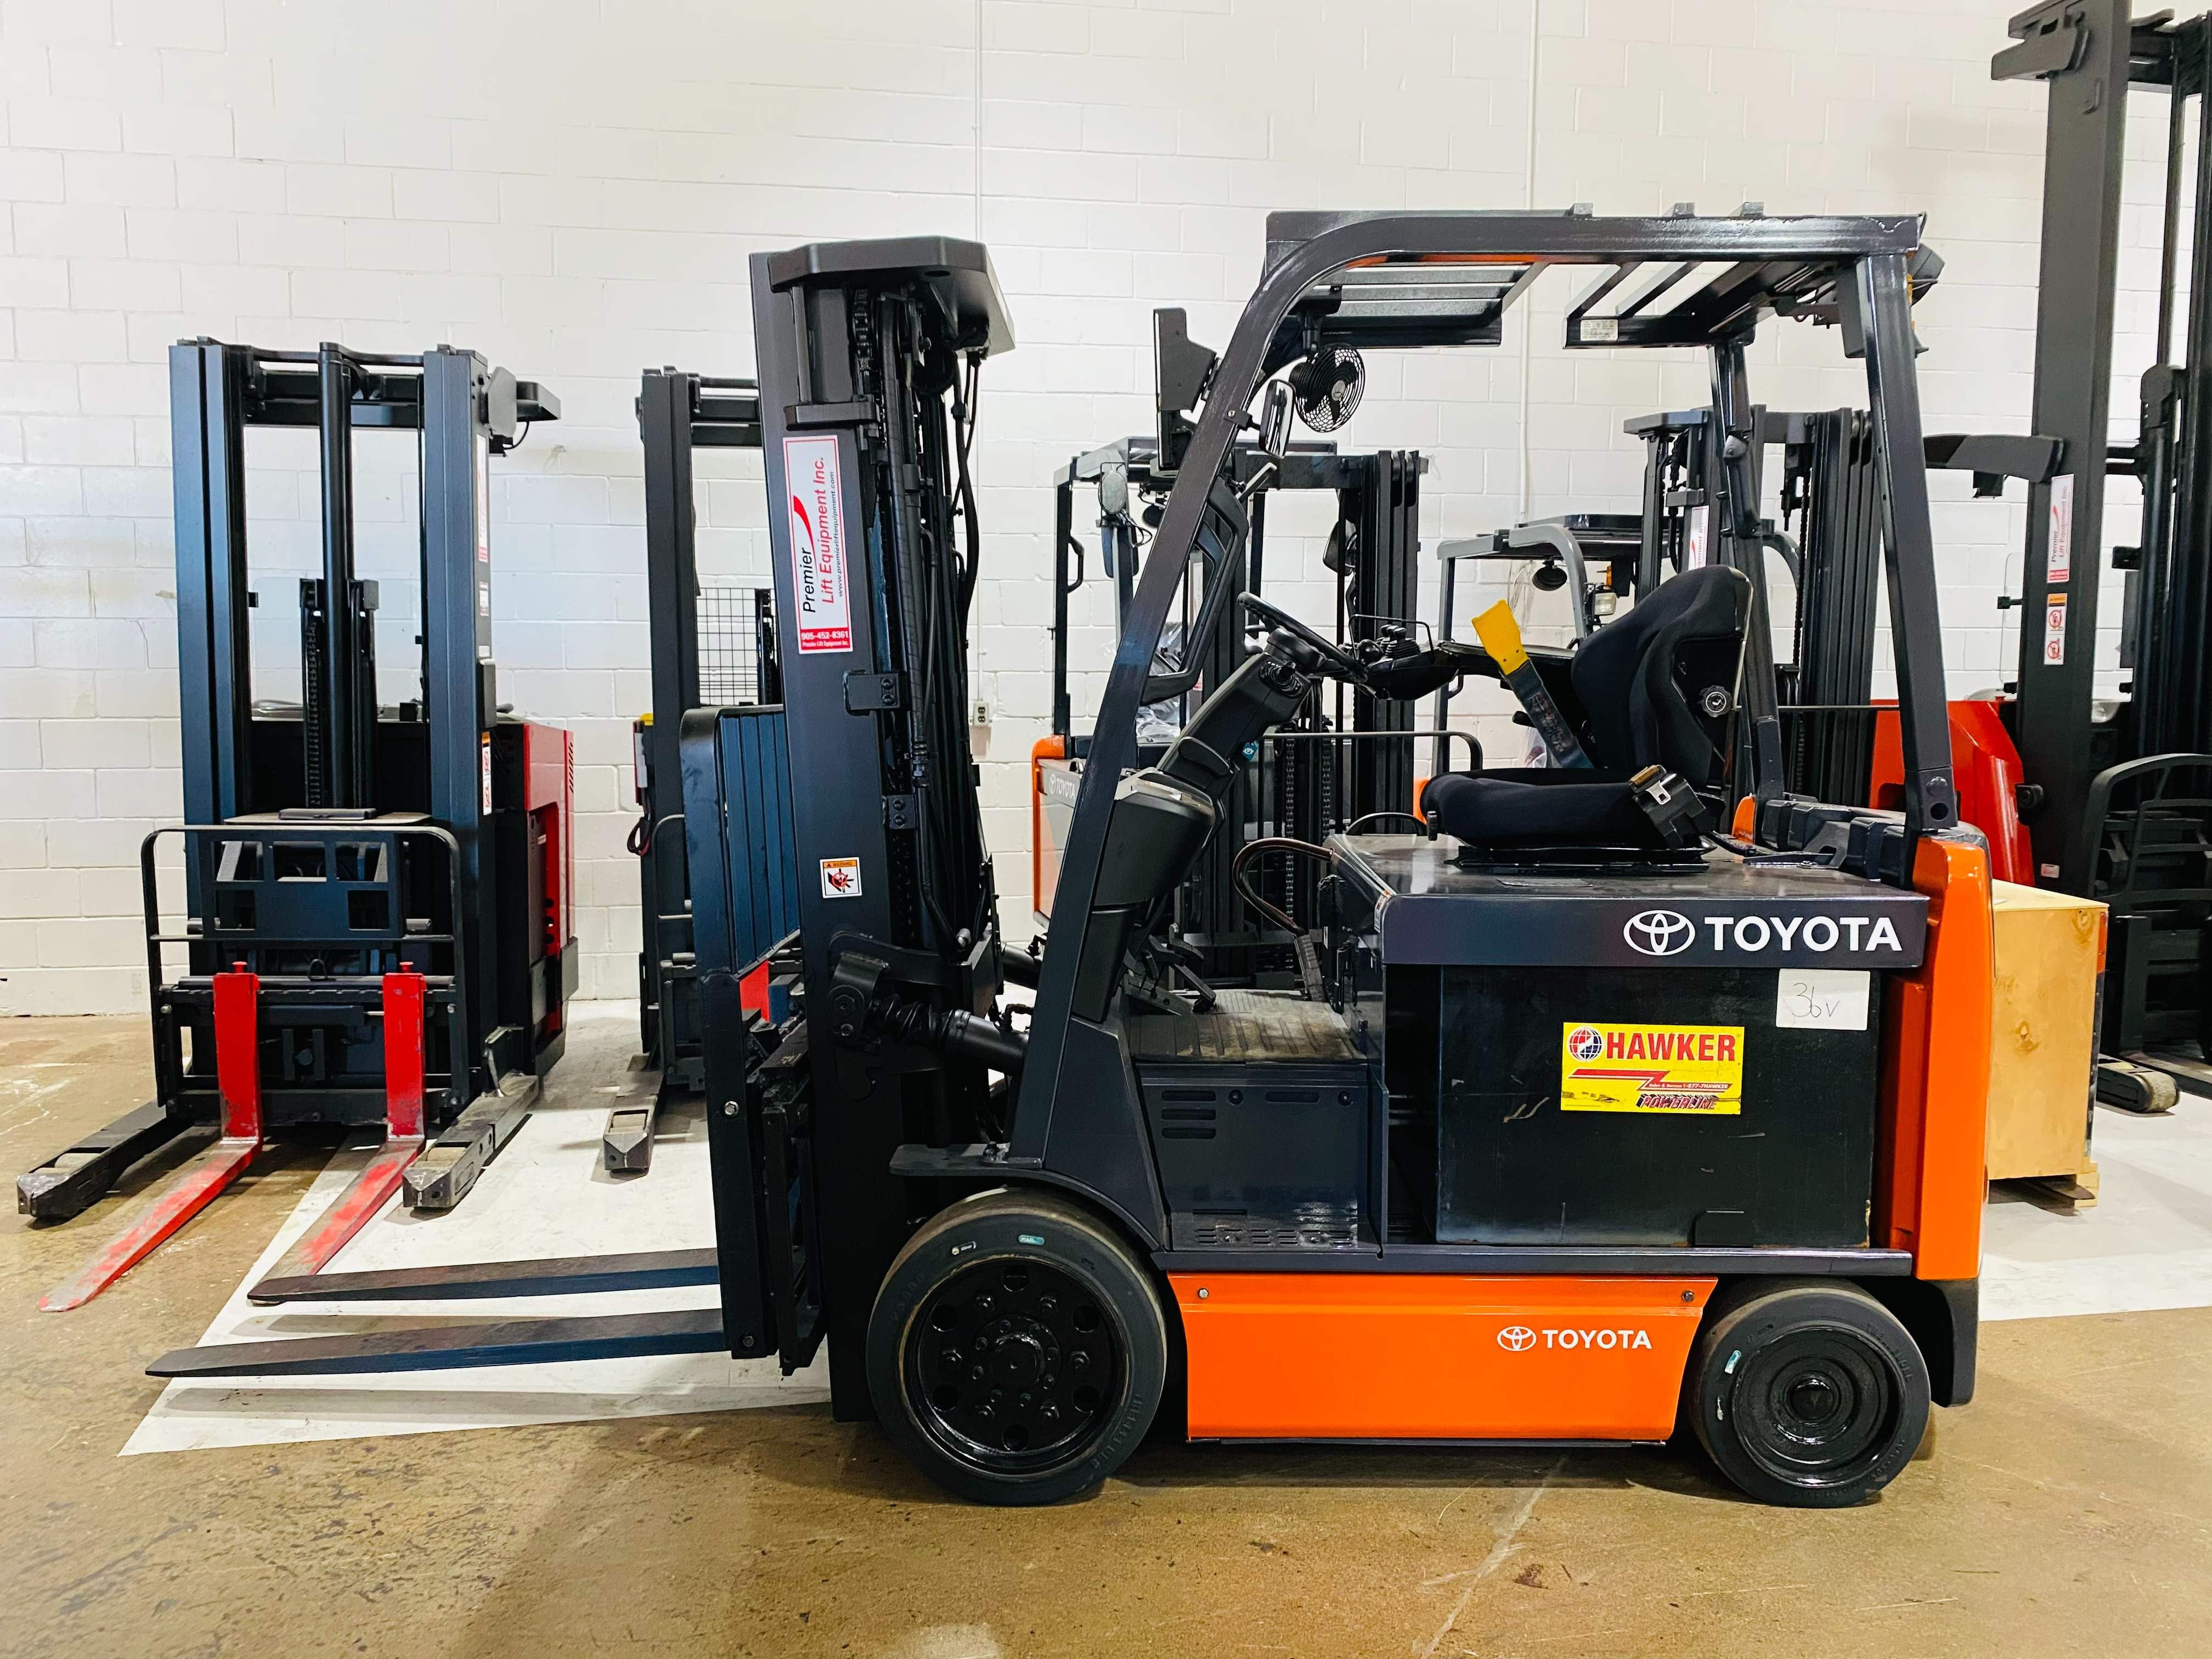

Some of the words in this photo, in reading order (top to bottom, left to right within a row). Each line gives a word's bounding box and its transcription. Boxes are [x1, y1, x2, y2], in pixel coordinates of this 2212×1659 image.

[813, 456, 825, 484] Inc.
[815, 489, 835, 572] Equipment
[830, 471, 844, 597] www.premierliftequipment.com
[800, 548, 815, 613] Premier
[821, 579, 834, 604] Lift
[801, 630, 848, 640] 905-452-8361
[1056, 778, 1075, 800] TOYOTA
[1704, 916, 1903, 952] TOYOTA
[1606, 1031, 1736, 1062] HAWKER
[1642, 1094, 1717, 1109] POWERLINE
[1542, 1329, 1653, 1350] TOYOTA
